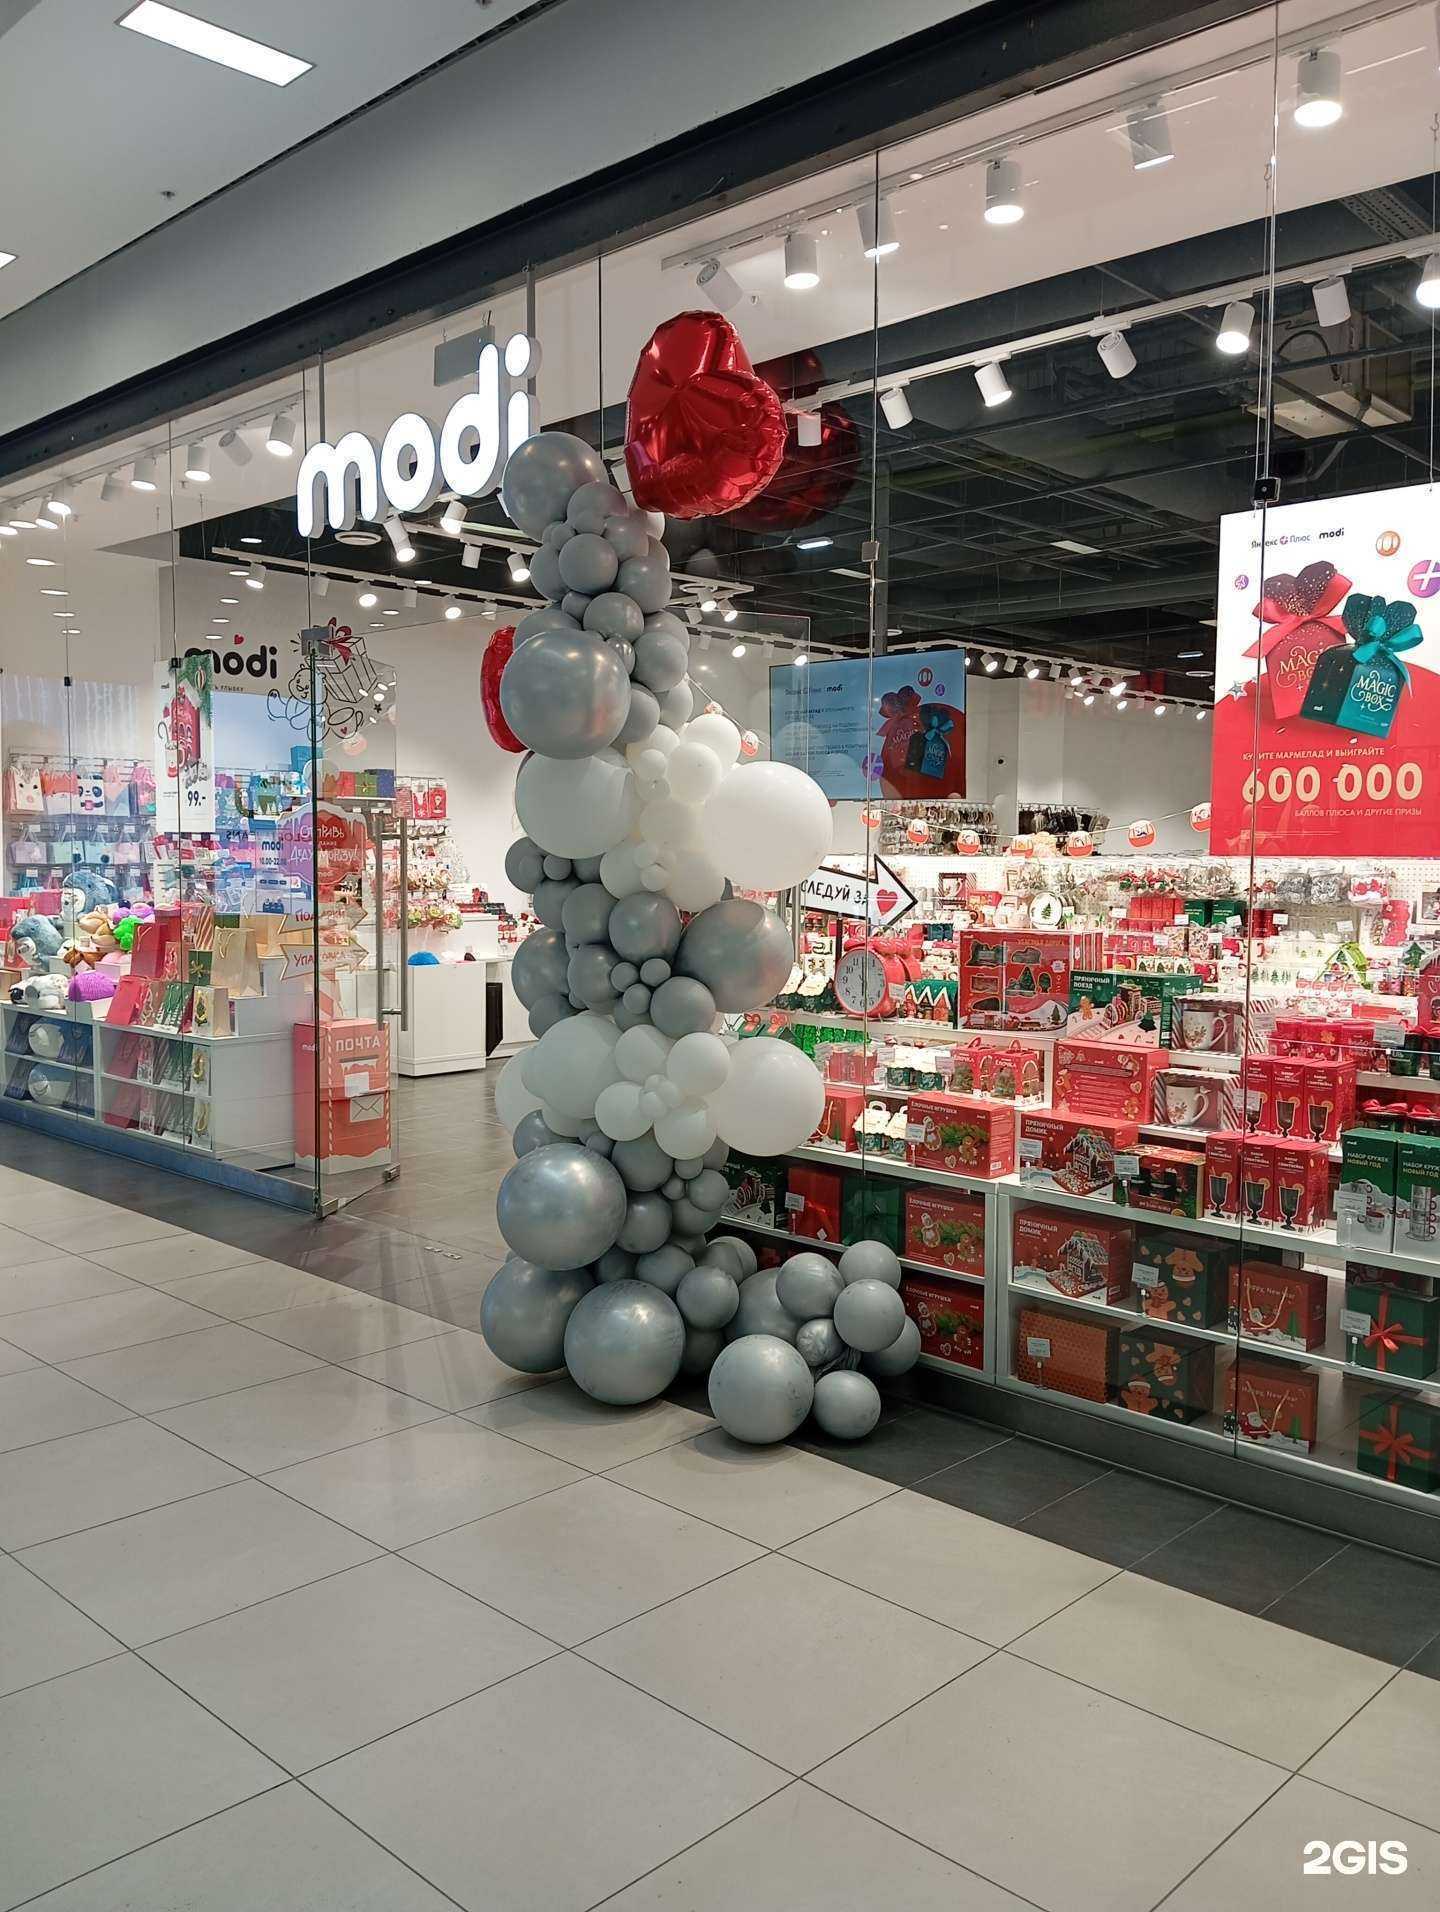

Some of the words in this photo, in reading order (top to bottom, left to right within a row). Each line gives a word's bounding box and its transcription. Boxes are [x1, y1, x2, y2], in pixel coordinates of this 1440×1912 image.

[297, 333, 533, 538] modi
[1319, 528, 1345, 539] modi
[1251, 538, 1278, 549] Янекс
[1289, 533, 1310, 543] Плюс
[1356, 670, 1397, 698] MAGIC
[1276, 750, 1325, 760] МАРМЕЛАД
[1327, 748, 1333, 757] И
[1335, 747, 1385, 757] ВЫИГРАЙТЕ
[1241, 765, 1321, 803] 600
[1336, 762, 1423, 802] 000
[1294, 808, 1325, 817] БАЛЛОВ
[1326, 808, 1356, 817] ПЛЮСА
[1364, 808, 1393, 817] ДРУГИЕ
[1394, 807, 1422, 816] ПРИЗЫ
[801, 879, 851, 902] СЛЕДУЙ
[335, 1034, 381, 1053] ПОЧТА
[1347, 1152, 1367, 1160] НАБОР
[1369, 1161, 1382, 1169] ГОД
[1402, 1161, 1422, 1169] НАБОР
[1402, 1168, 1425, 1176] НОВЫЙ
[1426, 1170, 1439, 1178] ГОД
